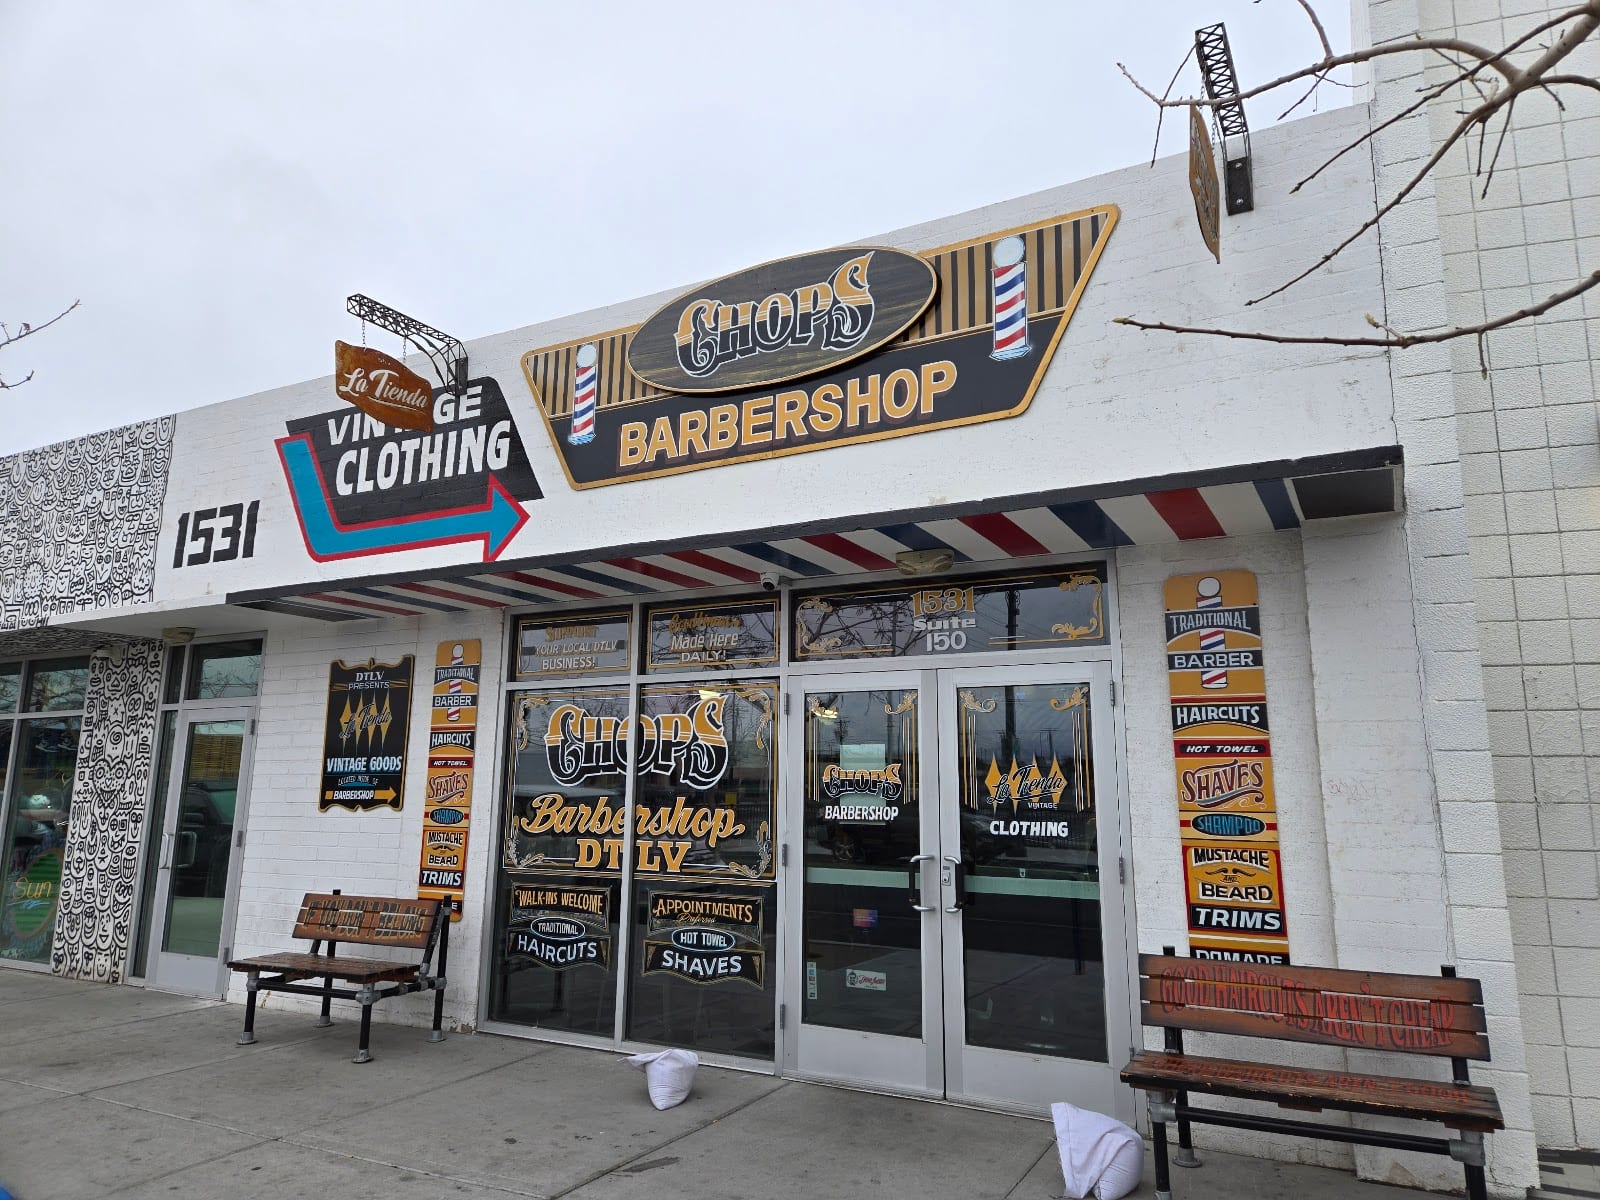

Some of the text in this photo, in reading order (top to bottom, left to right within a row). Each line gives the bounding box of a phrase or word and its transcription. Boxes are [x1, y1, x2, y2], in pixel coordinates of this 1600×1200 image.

[674, 250, 876, 378] CHOPS
[338, 368, 428, 408] La Tienda
[327, 385, 483, 446] VINGE
[619, 360, 958, 467] BARBERSHOP
[335, 420, 511, 496] CLOTHING
[173, 500, 260, 568] 1531
[910, 587, 976, 617] 1531
[914, 617, 977, 632] Suite
[1170, 611, 1251, 635] TRADITIONAL
[536, 639, 618, 656] YOUR LOCAL DTLV
[671, 632, 738, 650] Made Here
[926, 631, 967, 652] 150
[542, 656, 596, 670] BUSINESS!
[681, 650, 727, 662] DAILY!
[1174, 653, 1254, 668] BARBER
[355, 671, 384, 681] DTLV
[348, 682, 390, 690] PRESENTS
[434, 696, 472, 706] BARBER
[1176, 706, 1260, 725] HAIRCUTS
[431, 733, 471, 747] HAIRCUTS
[544, 695, 729, 789] CHOPS
[1186, 745, 1259, 753] HOT TOWEL
[326, 756, 402, 772] VINTAGE GOODS
[428, 771, 468, 799] SHAVES
[822, 763, 902, 801] CHOPS
[986, 764, 1064, 804] La Tienda
[1181, 758, 1264, 802] SHAVES
[333, 790, 375, 800] BARBERSHOP
[824, 805, 899, 821] BARBERSHOP
[1028, 801, 1058, 809] VINTAGE
[432, 812, 463, 825] SHAMPOO
[521, 793, 746, 847] Barbershop
[1197, 815, 1261, 835] SHAMPOO
[990, 820, 1069, 837] CLOTHING
[427, 831, 464, 846] MUSTACHE
[428, 854, 459, 867] BEARD
[575, 838, 692, 872] DTLV
[1193, 847, 1269, 870] MUSTACHE
[421, 871, 462, 886] TRIMS
[1200, 882, 1273, 901] BEARD
[515, 889, 603, 915] WALK-INS WELCOME
[652, 898, 753, 923] APPOINTMENTS
[1195, 907, 1281, 930] TRIMS
[537, 922, 579, 935] TRADITIONAL
[517, 935, 597, 963] HAIRCUTS
[680, 932, 727, 947] HOT TOWEL
[662, 950, 742, 976] SHAVES
[1162, 964, 1454, 1048] GOOD HAIRCUTS AREN'T CHEAP
